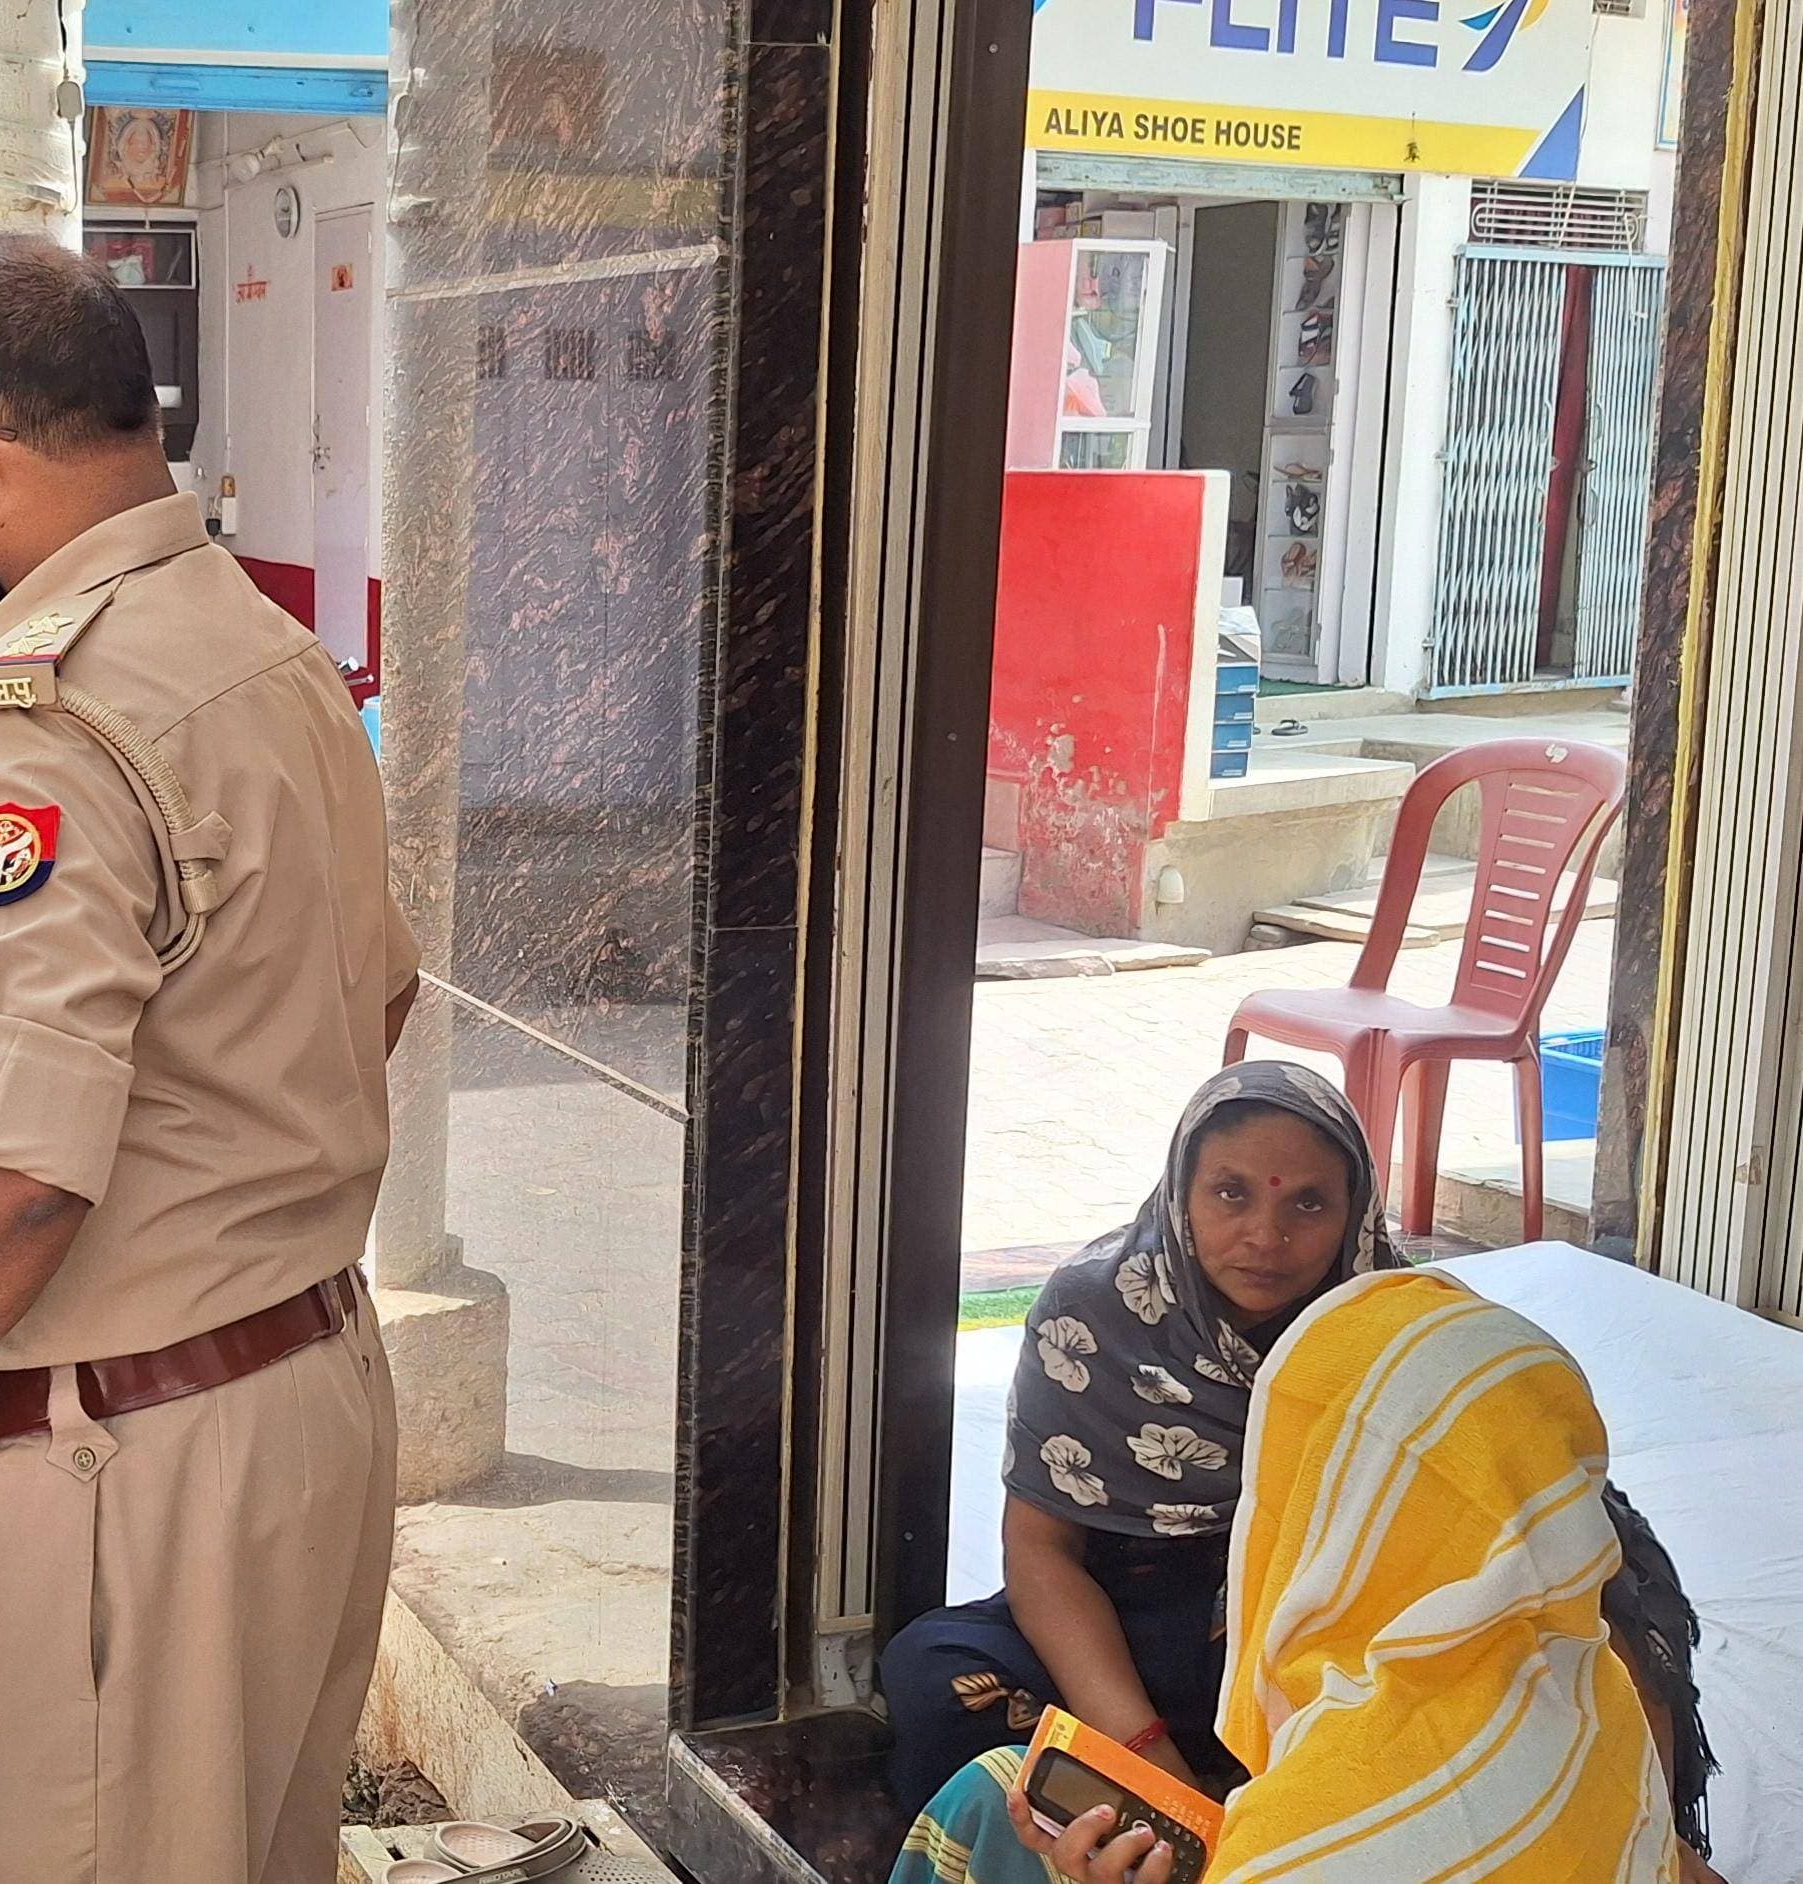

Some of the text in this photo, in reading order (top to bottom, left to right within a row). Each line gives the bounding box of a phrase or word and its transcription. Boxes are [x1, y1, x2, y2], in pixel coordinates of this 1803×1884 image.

[1133, 0, 1440, 68] LIE
[1044, 108, 1302, 150] ALIYA SHOE HOUSE
